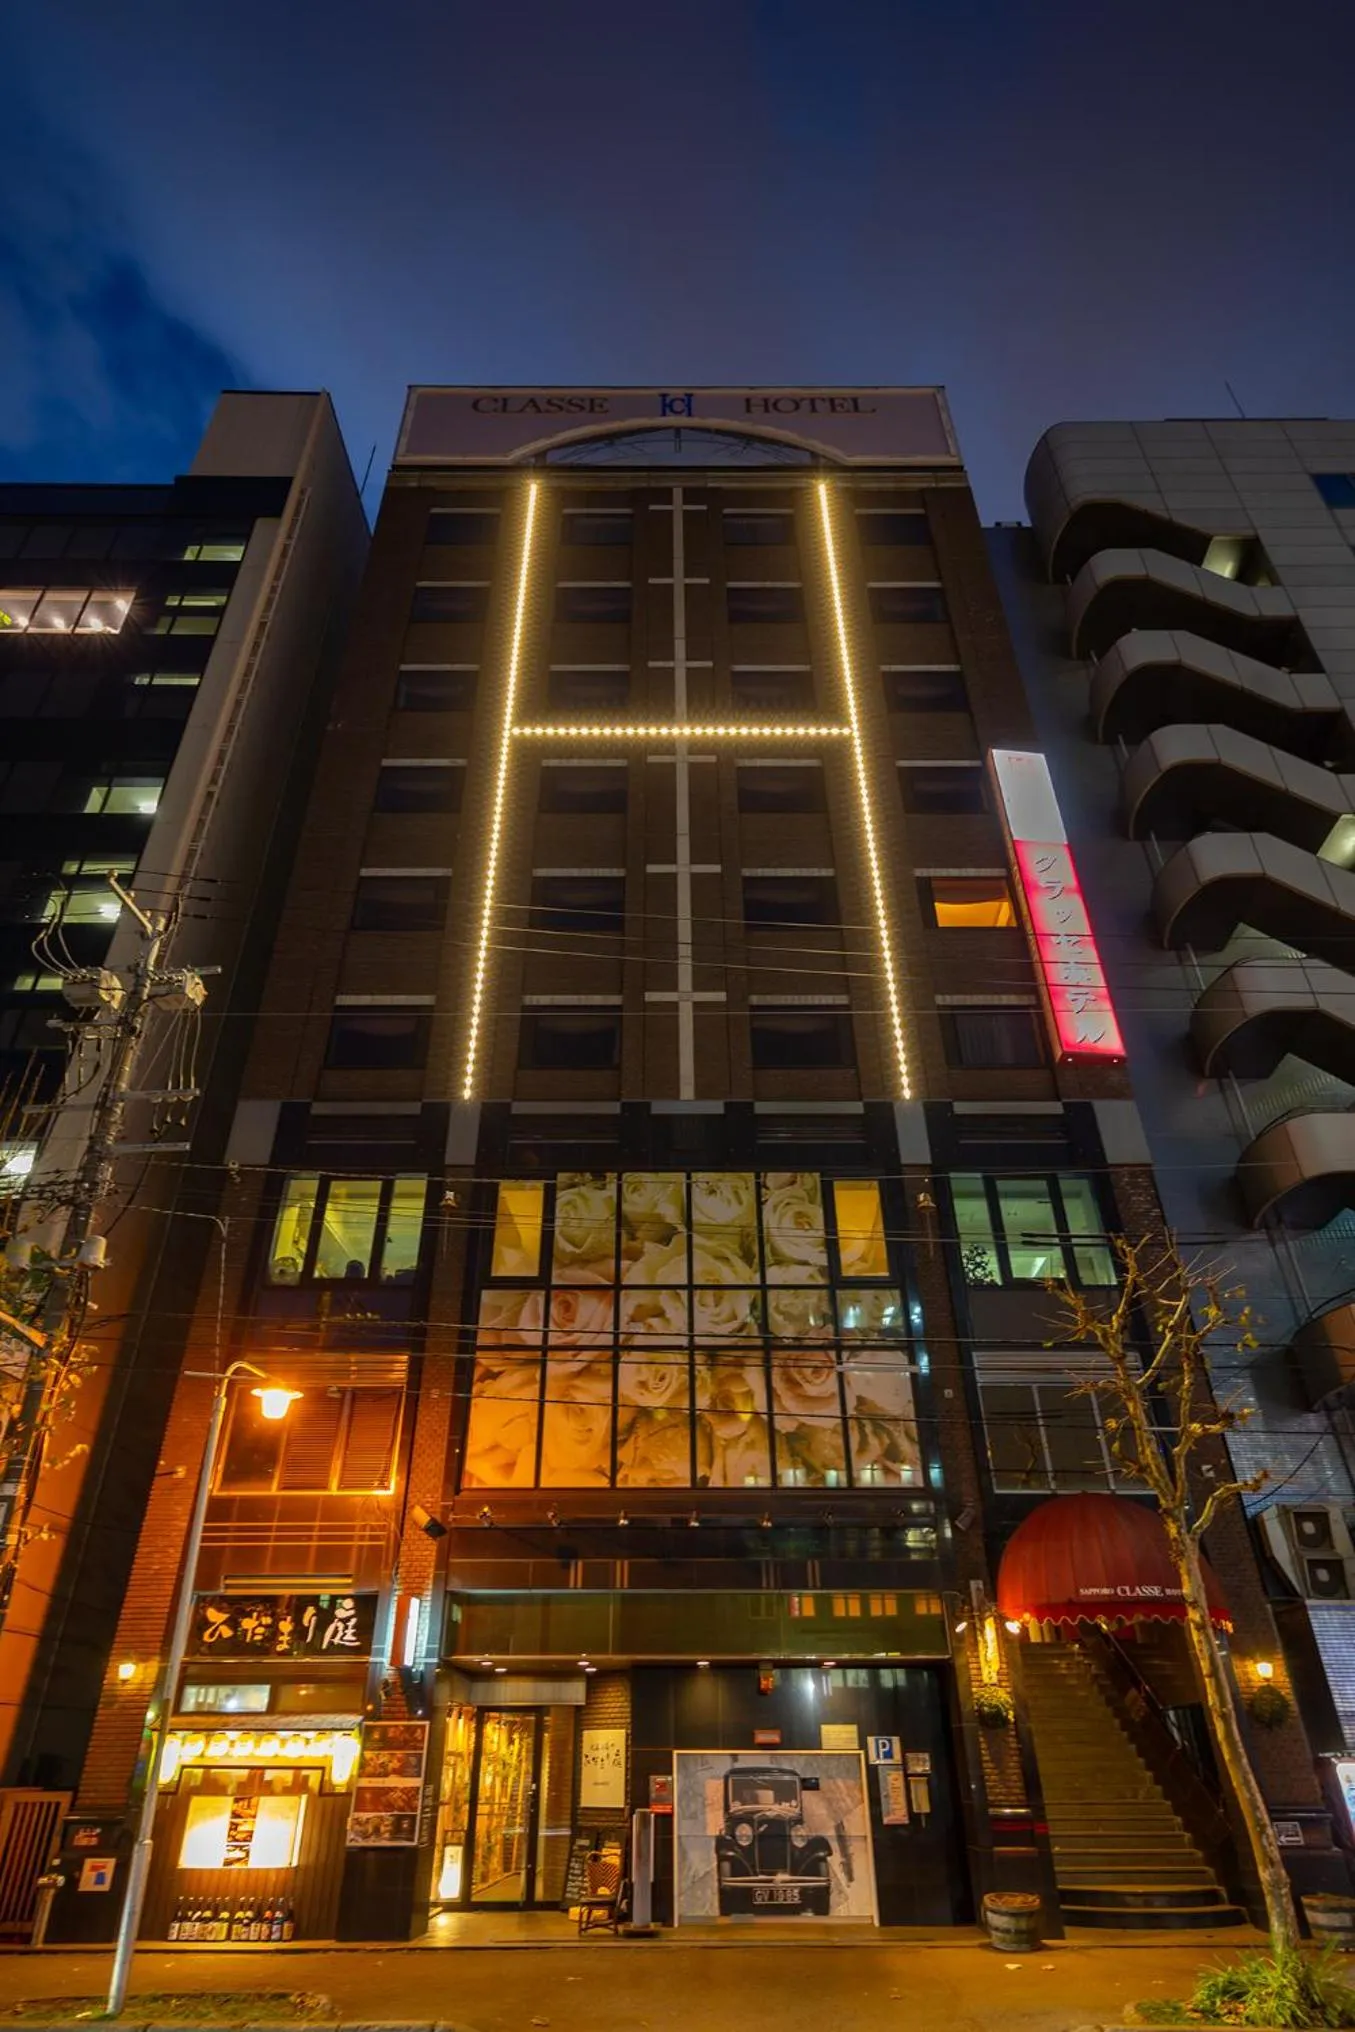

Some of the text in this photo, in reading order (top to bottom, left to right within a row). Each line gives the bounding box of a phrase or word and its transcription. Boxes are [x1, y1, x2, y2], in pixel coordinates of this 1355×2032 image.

[471, 397, 877, 414] CLASSE HOTEL
[1117, 1585, 1164, 1597] CLASSE
[878, 1739, 891, 1761] P
